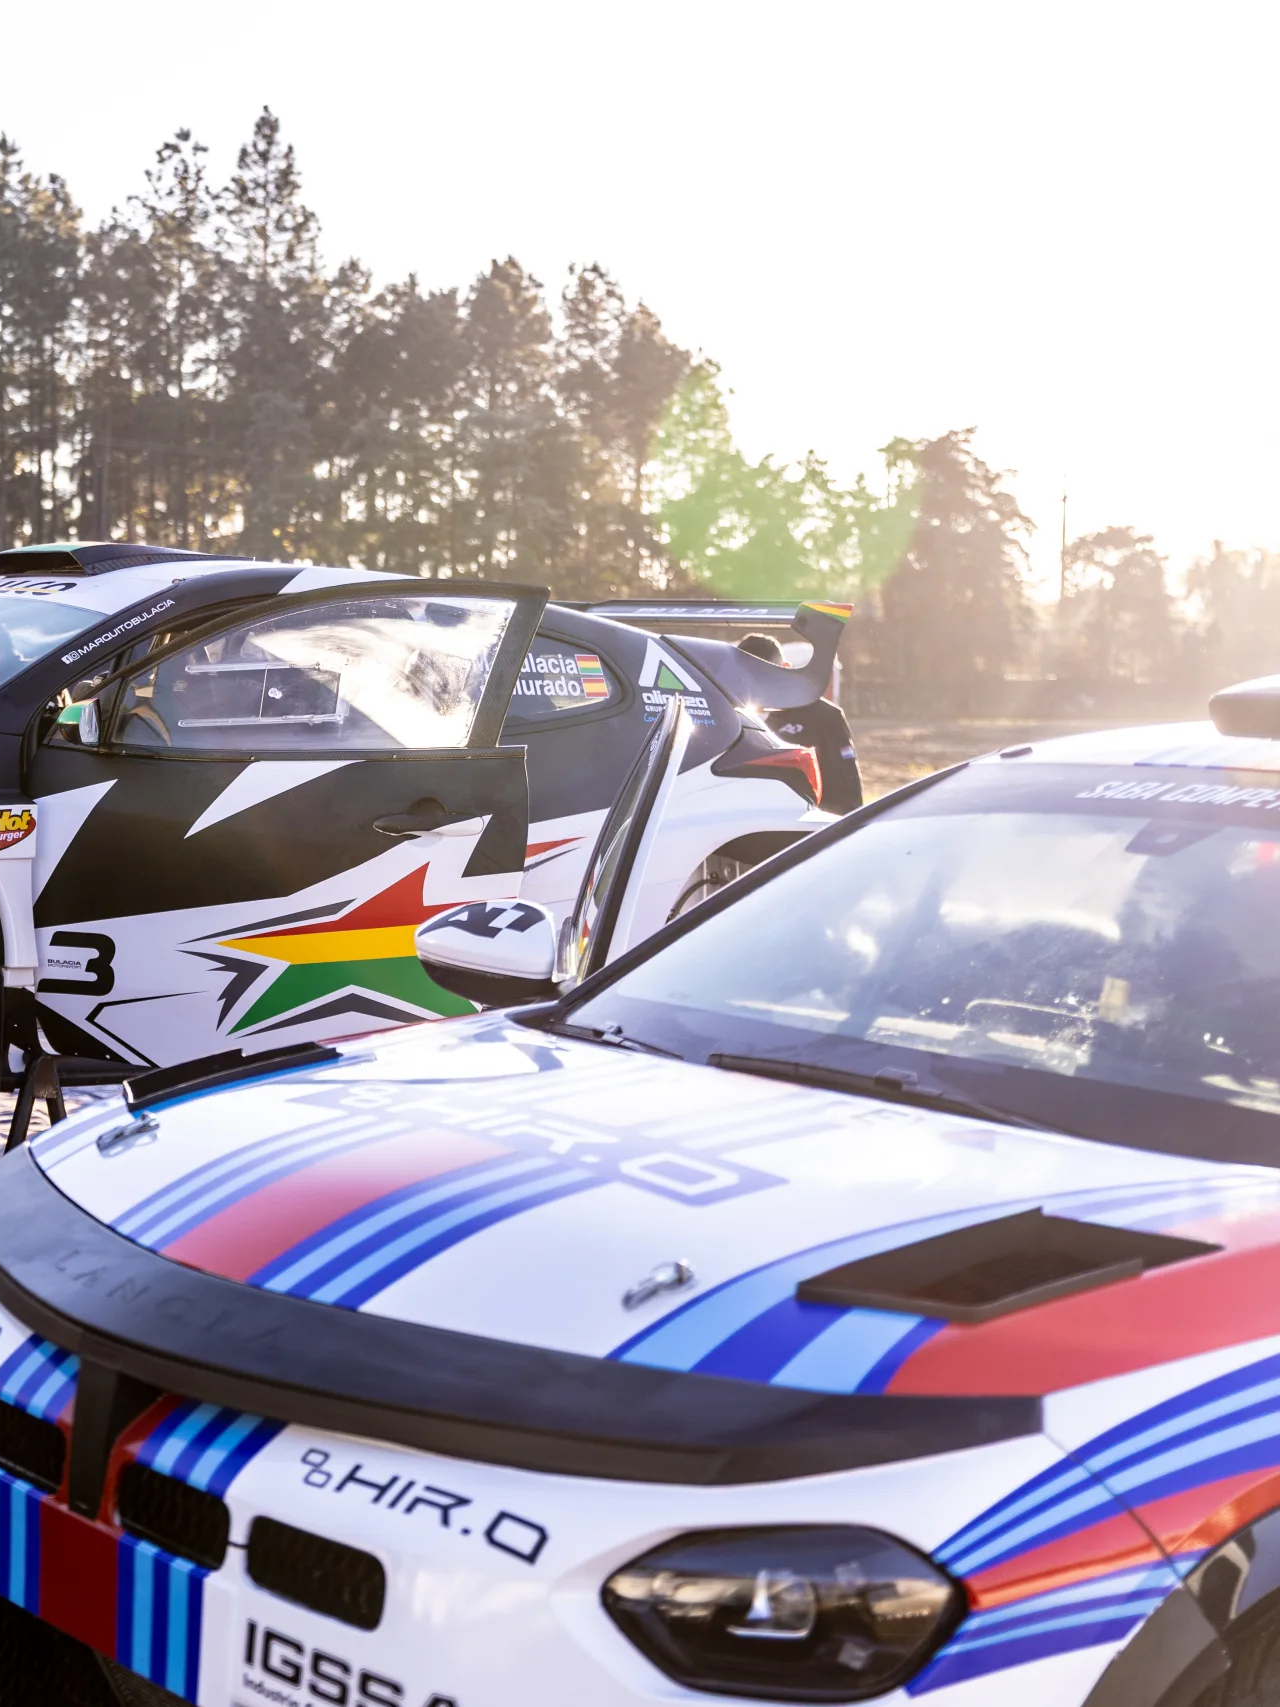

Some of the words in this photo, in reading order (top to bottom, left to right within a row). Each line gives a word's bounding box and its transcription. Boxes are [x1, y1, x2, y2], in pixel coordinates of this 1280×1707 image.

[78, 599, 176, 656] MARQUITOBULACIA
[521, 653, 579, 675] ulacia
[36, 930, 116, 996] 3
[47, 958, 81, 966] BULACIA
